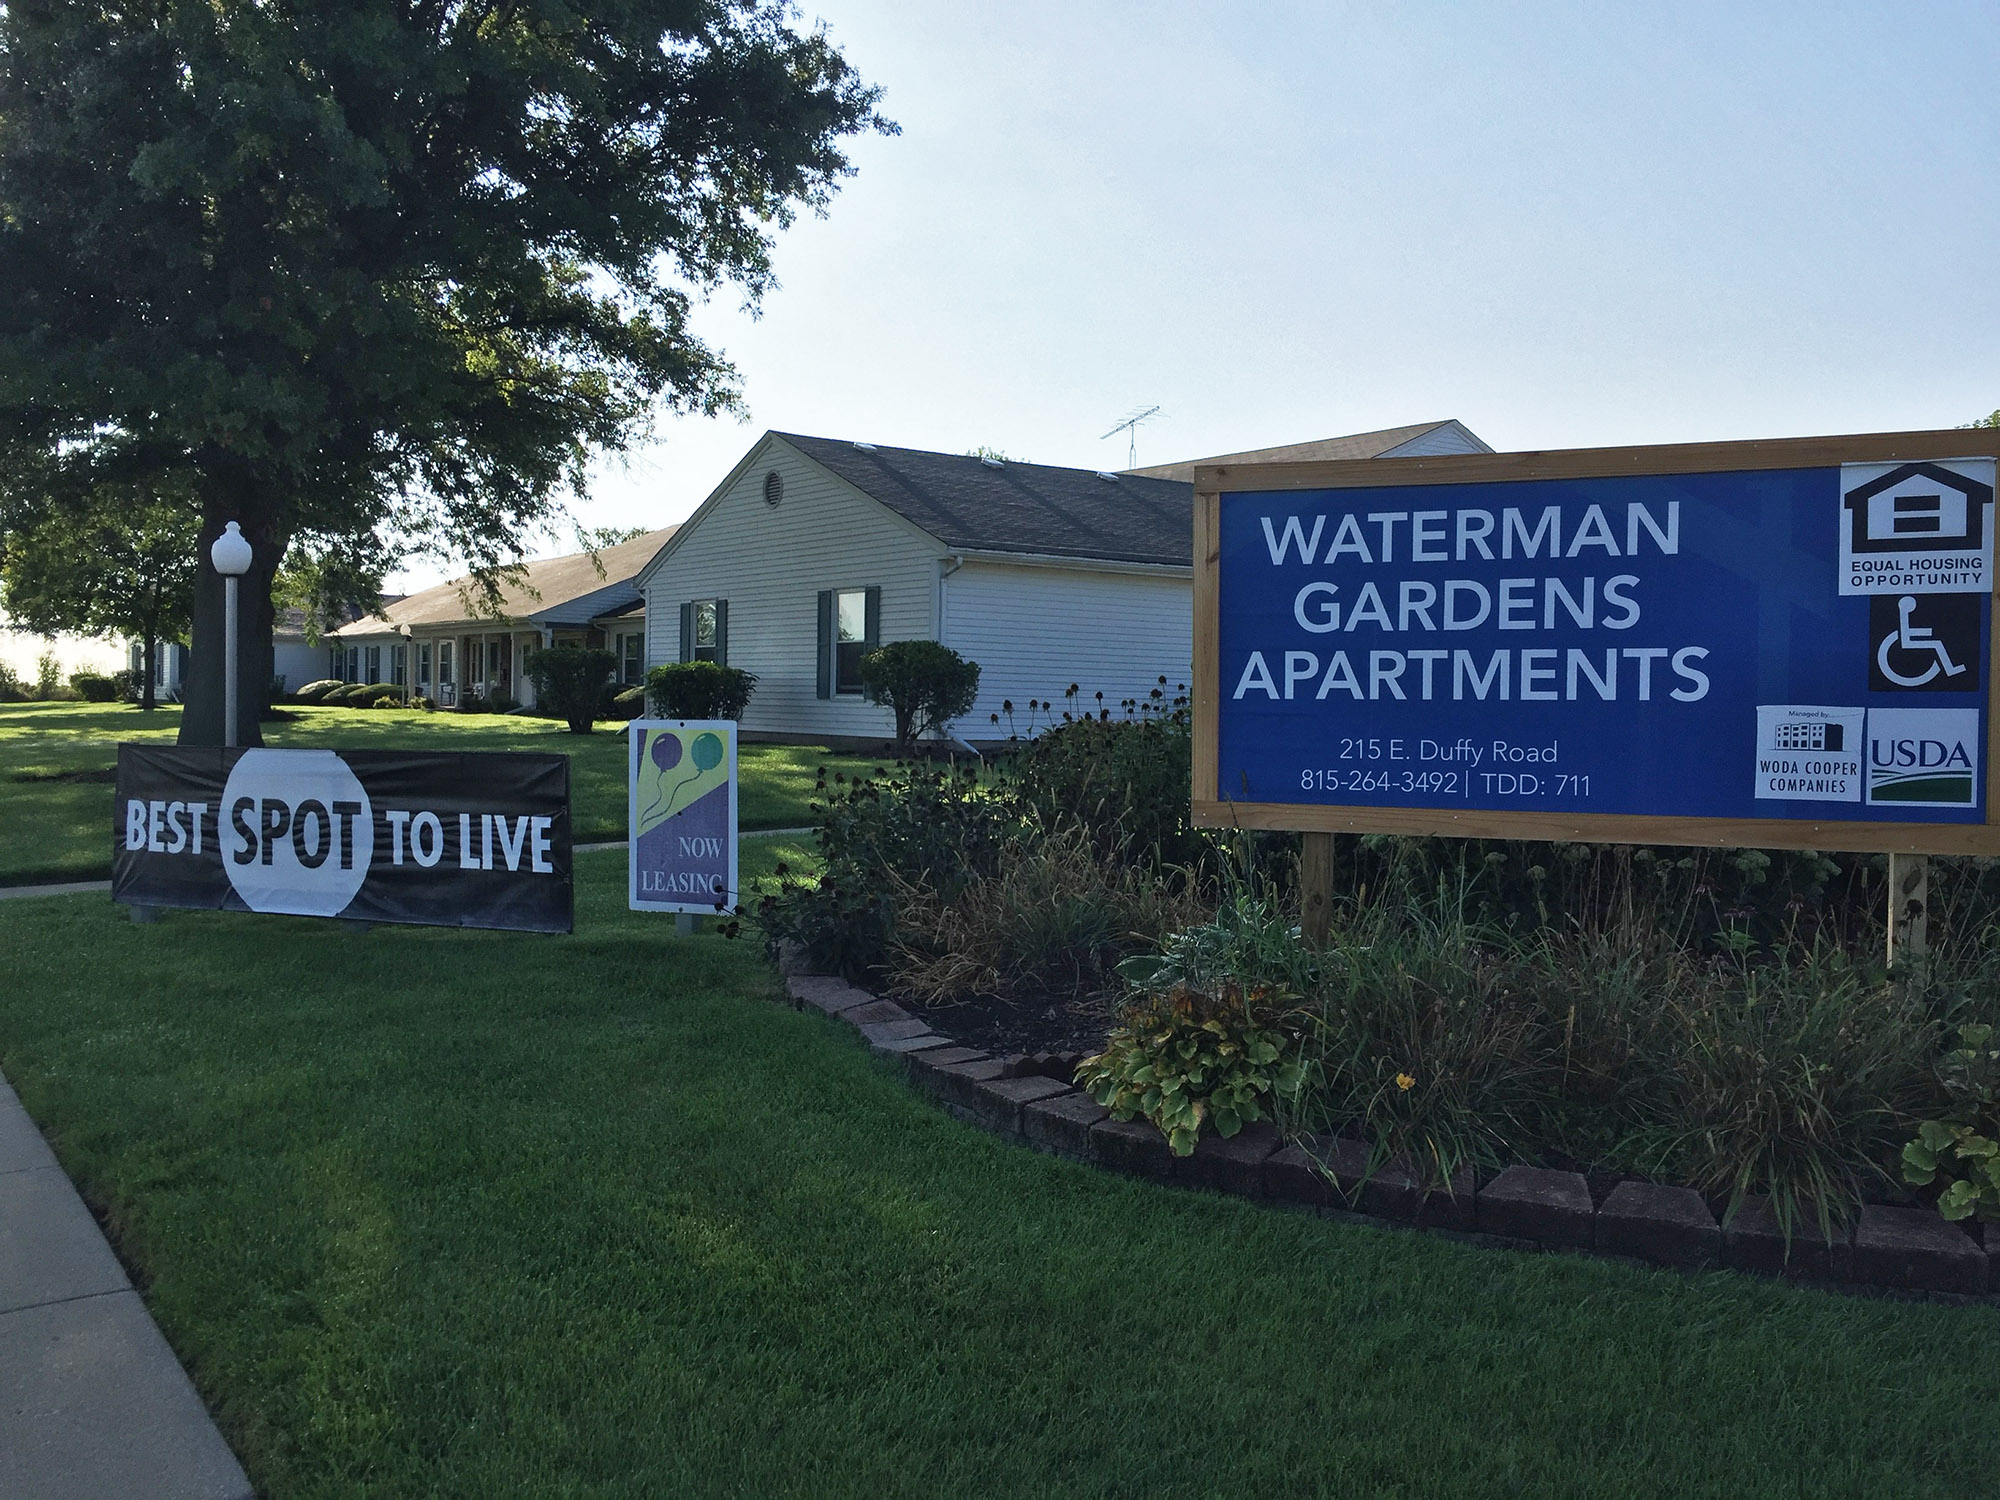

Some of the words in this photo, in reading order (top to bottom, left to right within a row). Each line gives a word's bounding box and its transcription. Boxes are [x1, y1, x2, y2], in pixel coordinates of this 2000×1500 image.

[1260, 501, 1680, 566] WATERMAN
[1852, 560, 1904, 572] EQUAL
[1909, 557, 1983, 571] HOUSING
[1851, 572, 1982, 587] OPPORTUNITY
[1294, 574, 1641, 633] GARDENS
[1232, 646, 1711, 703] APARTMENTS
[1788, 710, 1819, 718] Managed
[1340, 738, 1381, 760] 215
[1390, 739, 1410, 760] E.
[1420, 739, 1484, 767] Duffy
[1493, 740, 1558, 763] Road
[1872, 739, 1973, 768] USDA
[1760, 760, 1799, 774] WODA
[1805, 761, 1857, 776] COOPER
[1300, 769, 1458, 794] 815-264-3492
[1480, 773, 1546, 796] TDD:
[1555, 775, 1591, 797] 711
[1769, 778, 1846, 793] COMPANIES
[126, 799, 208, 855] BEST
[232, 796, 362, 870] SPOT
[386, 810, 444, 868] TO
[459, 813, 554, 874] LIVE
[679, 836, 724, 859] NOW
